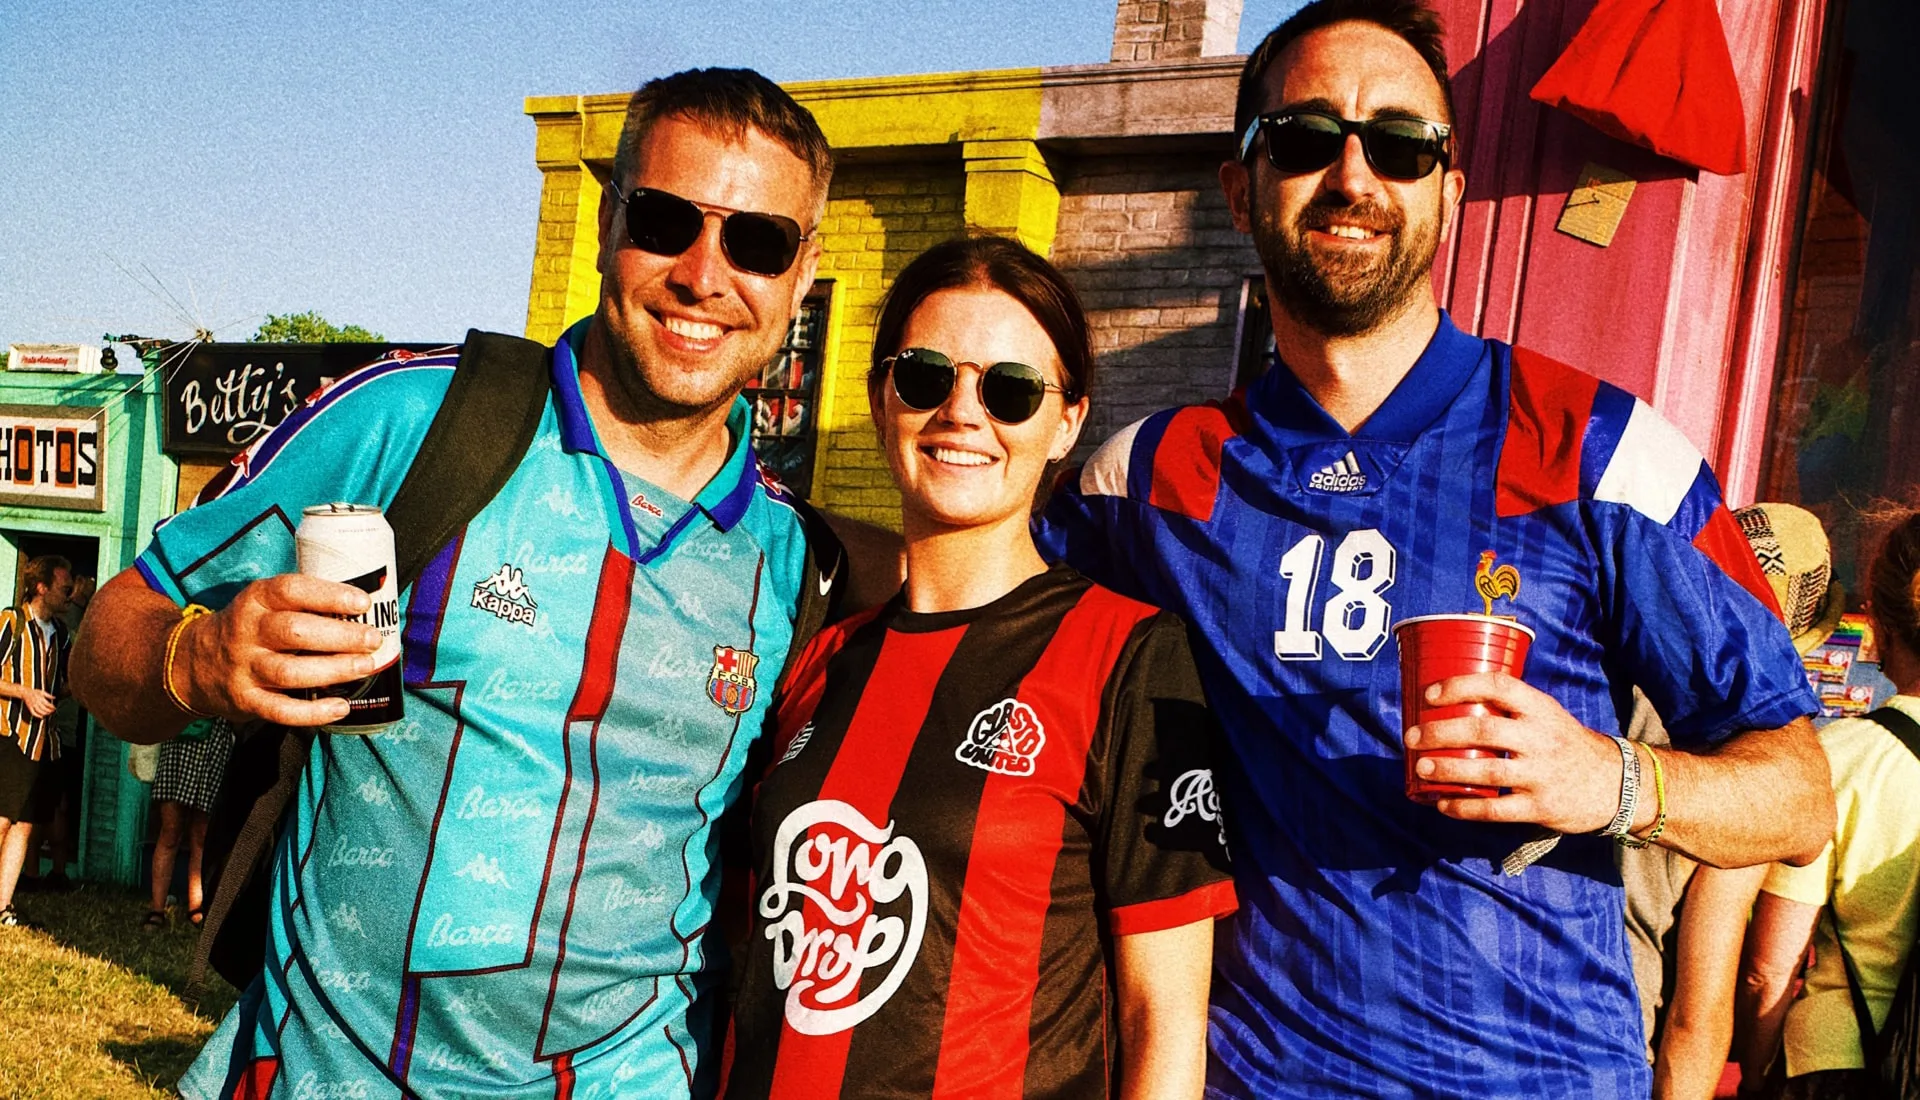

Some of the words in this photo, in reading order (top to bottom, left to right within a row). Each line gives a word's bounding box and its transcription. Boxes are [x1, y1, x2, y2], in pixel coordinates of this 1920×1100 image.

[180, 361, 299, 444] Betty's
[0, 428, 97, 486] HOTOS
[1311, 472, 1367, 487] adidas
[1308, 482, 1363, 492] EQUIPMENT
[471, 587, 536, 627] Kappa
[1274, 529, 1396, 661] 18
[959, 743, 1031, 773] UNITED
[1611, 776, 1636, 832] STONBURY
[765, 910, 905, 1004] Drop
